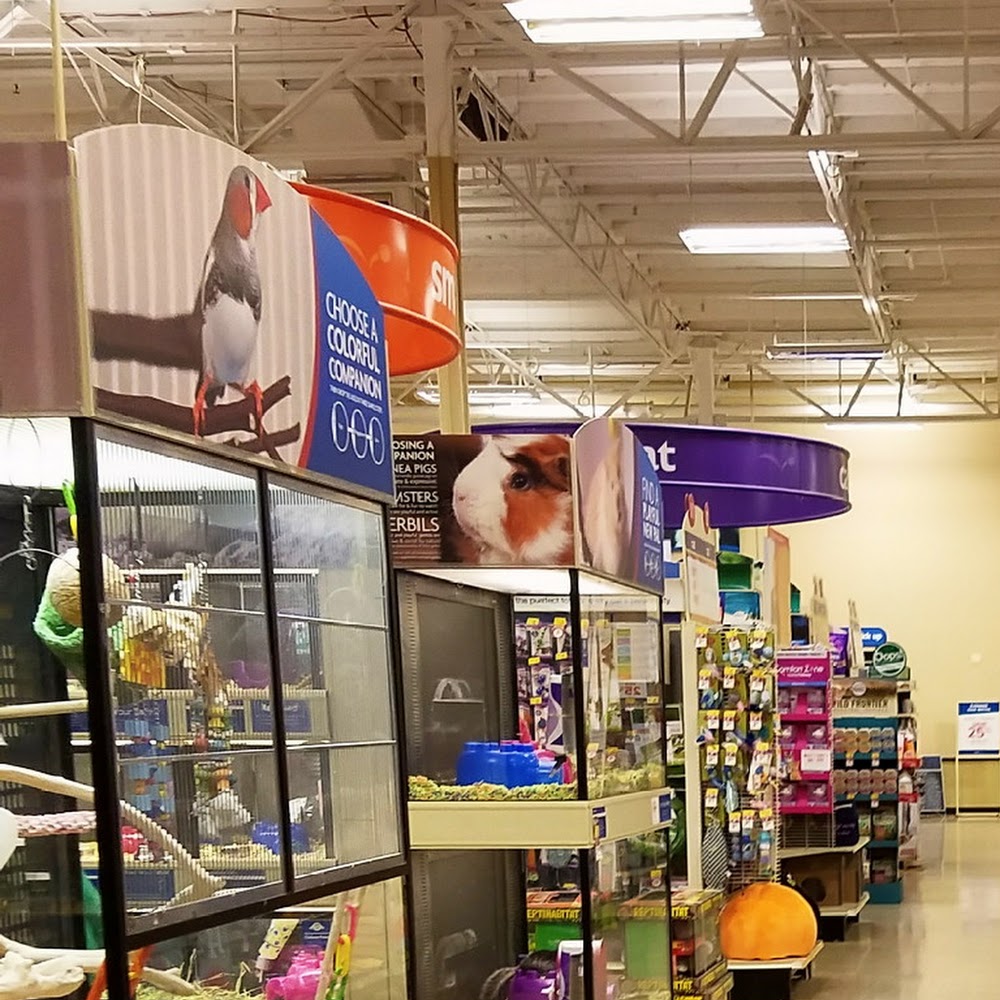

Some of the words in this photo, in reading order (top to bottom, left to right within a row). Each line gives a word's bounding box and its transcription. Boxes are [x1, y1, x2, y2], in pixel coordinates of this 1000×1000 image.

[326, 291, 369, 340] CHOOSE
[371, 318, 379, 344] A
[327, 324, 381, 374] COLORFUL
[328, 357, 382, 401] COMPANION
[427, 441, 434, 450] A
[414, 464, 437, 473] PIGS
